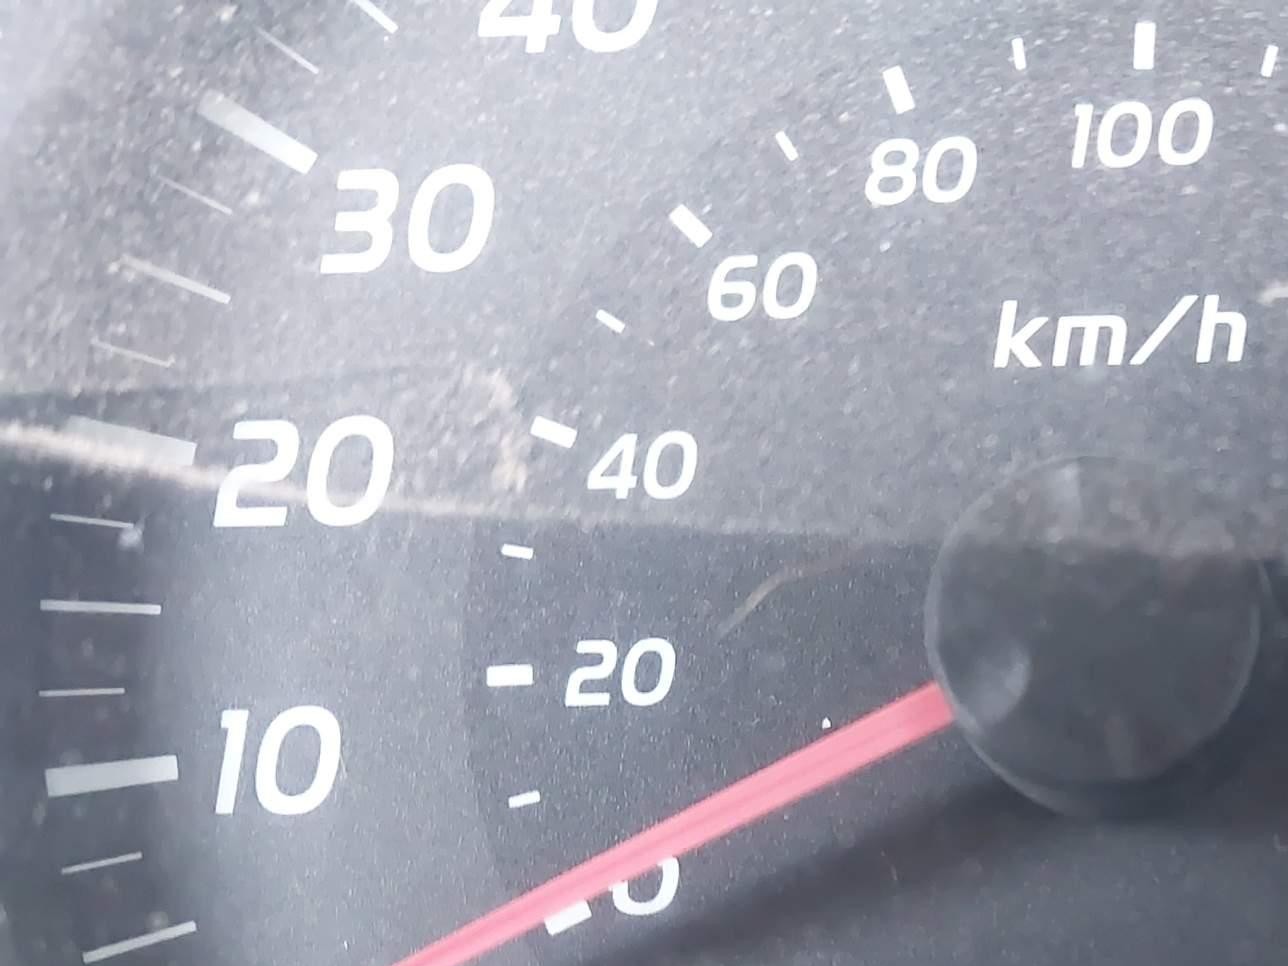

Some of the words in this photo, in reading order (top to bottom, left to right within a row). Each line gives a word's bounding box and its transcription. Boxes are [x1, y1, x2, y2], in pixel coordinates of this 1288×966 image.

[1071, 98, 1214, 169] 100
[864, 136, 978, 207] 80
[320, 164, 495, 274] 30
[707, 251, 818, 322] 60
[993, 294, 1248, 369] km/h
[212, 414, 394, 527] 20
[586, 430, 698, 500] 40
[564, 637, 676, 707] 20
[215, 704, 342, 816] 10
